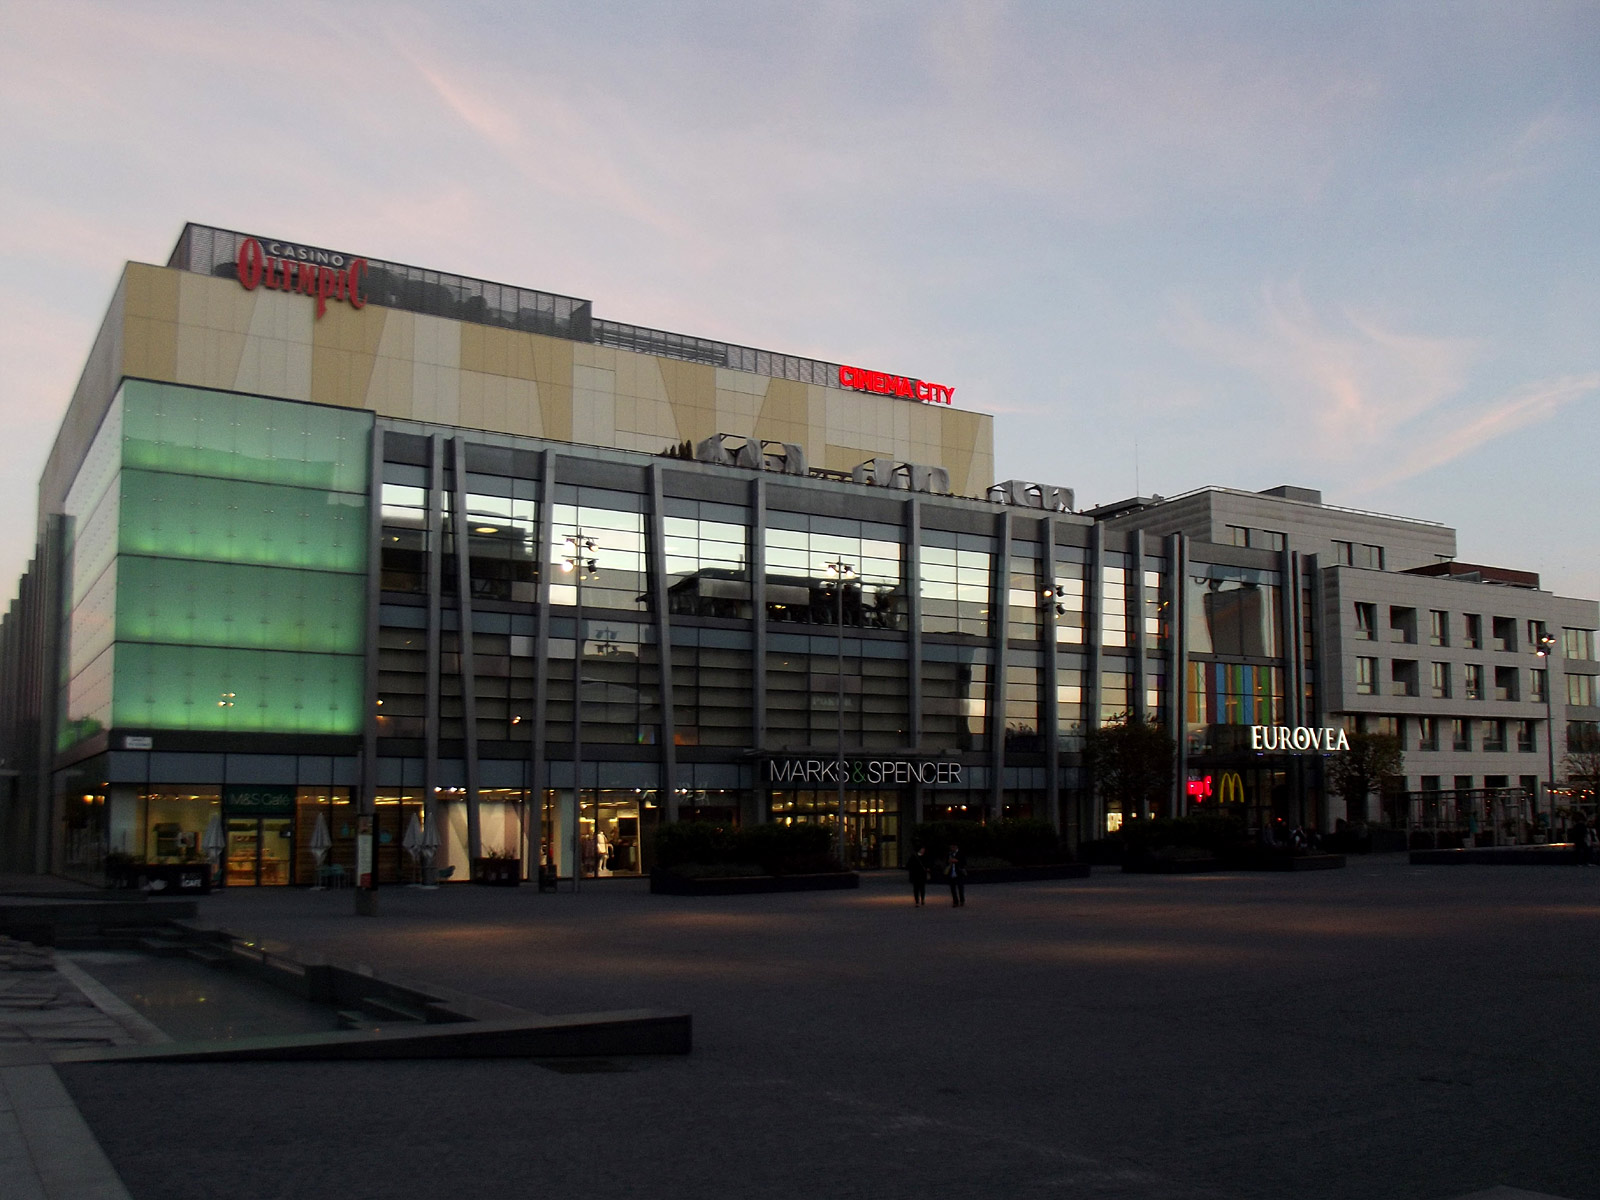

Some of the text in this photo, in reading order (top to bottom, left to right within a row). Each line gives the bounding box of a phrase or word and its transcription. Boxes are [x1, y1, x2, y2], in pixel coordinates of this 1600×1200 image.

[271, 243, 345, 268] CASINO
[839, 364, 955, 405] CINEMA CITY
[1250, 725, 1350, 750] EUROVEA
